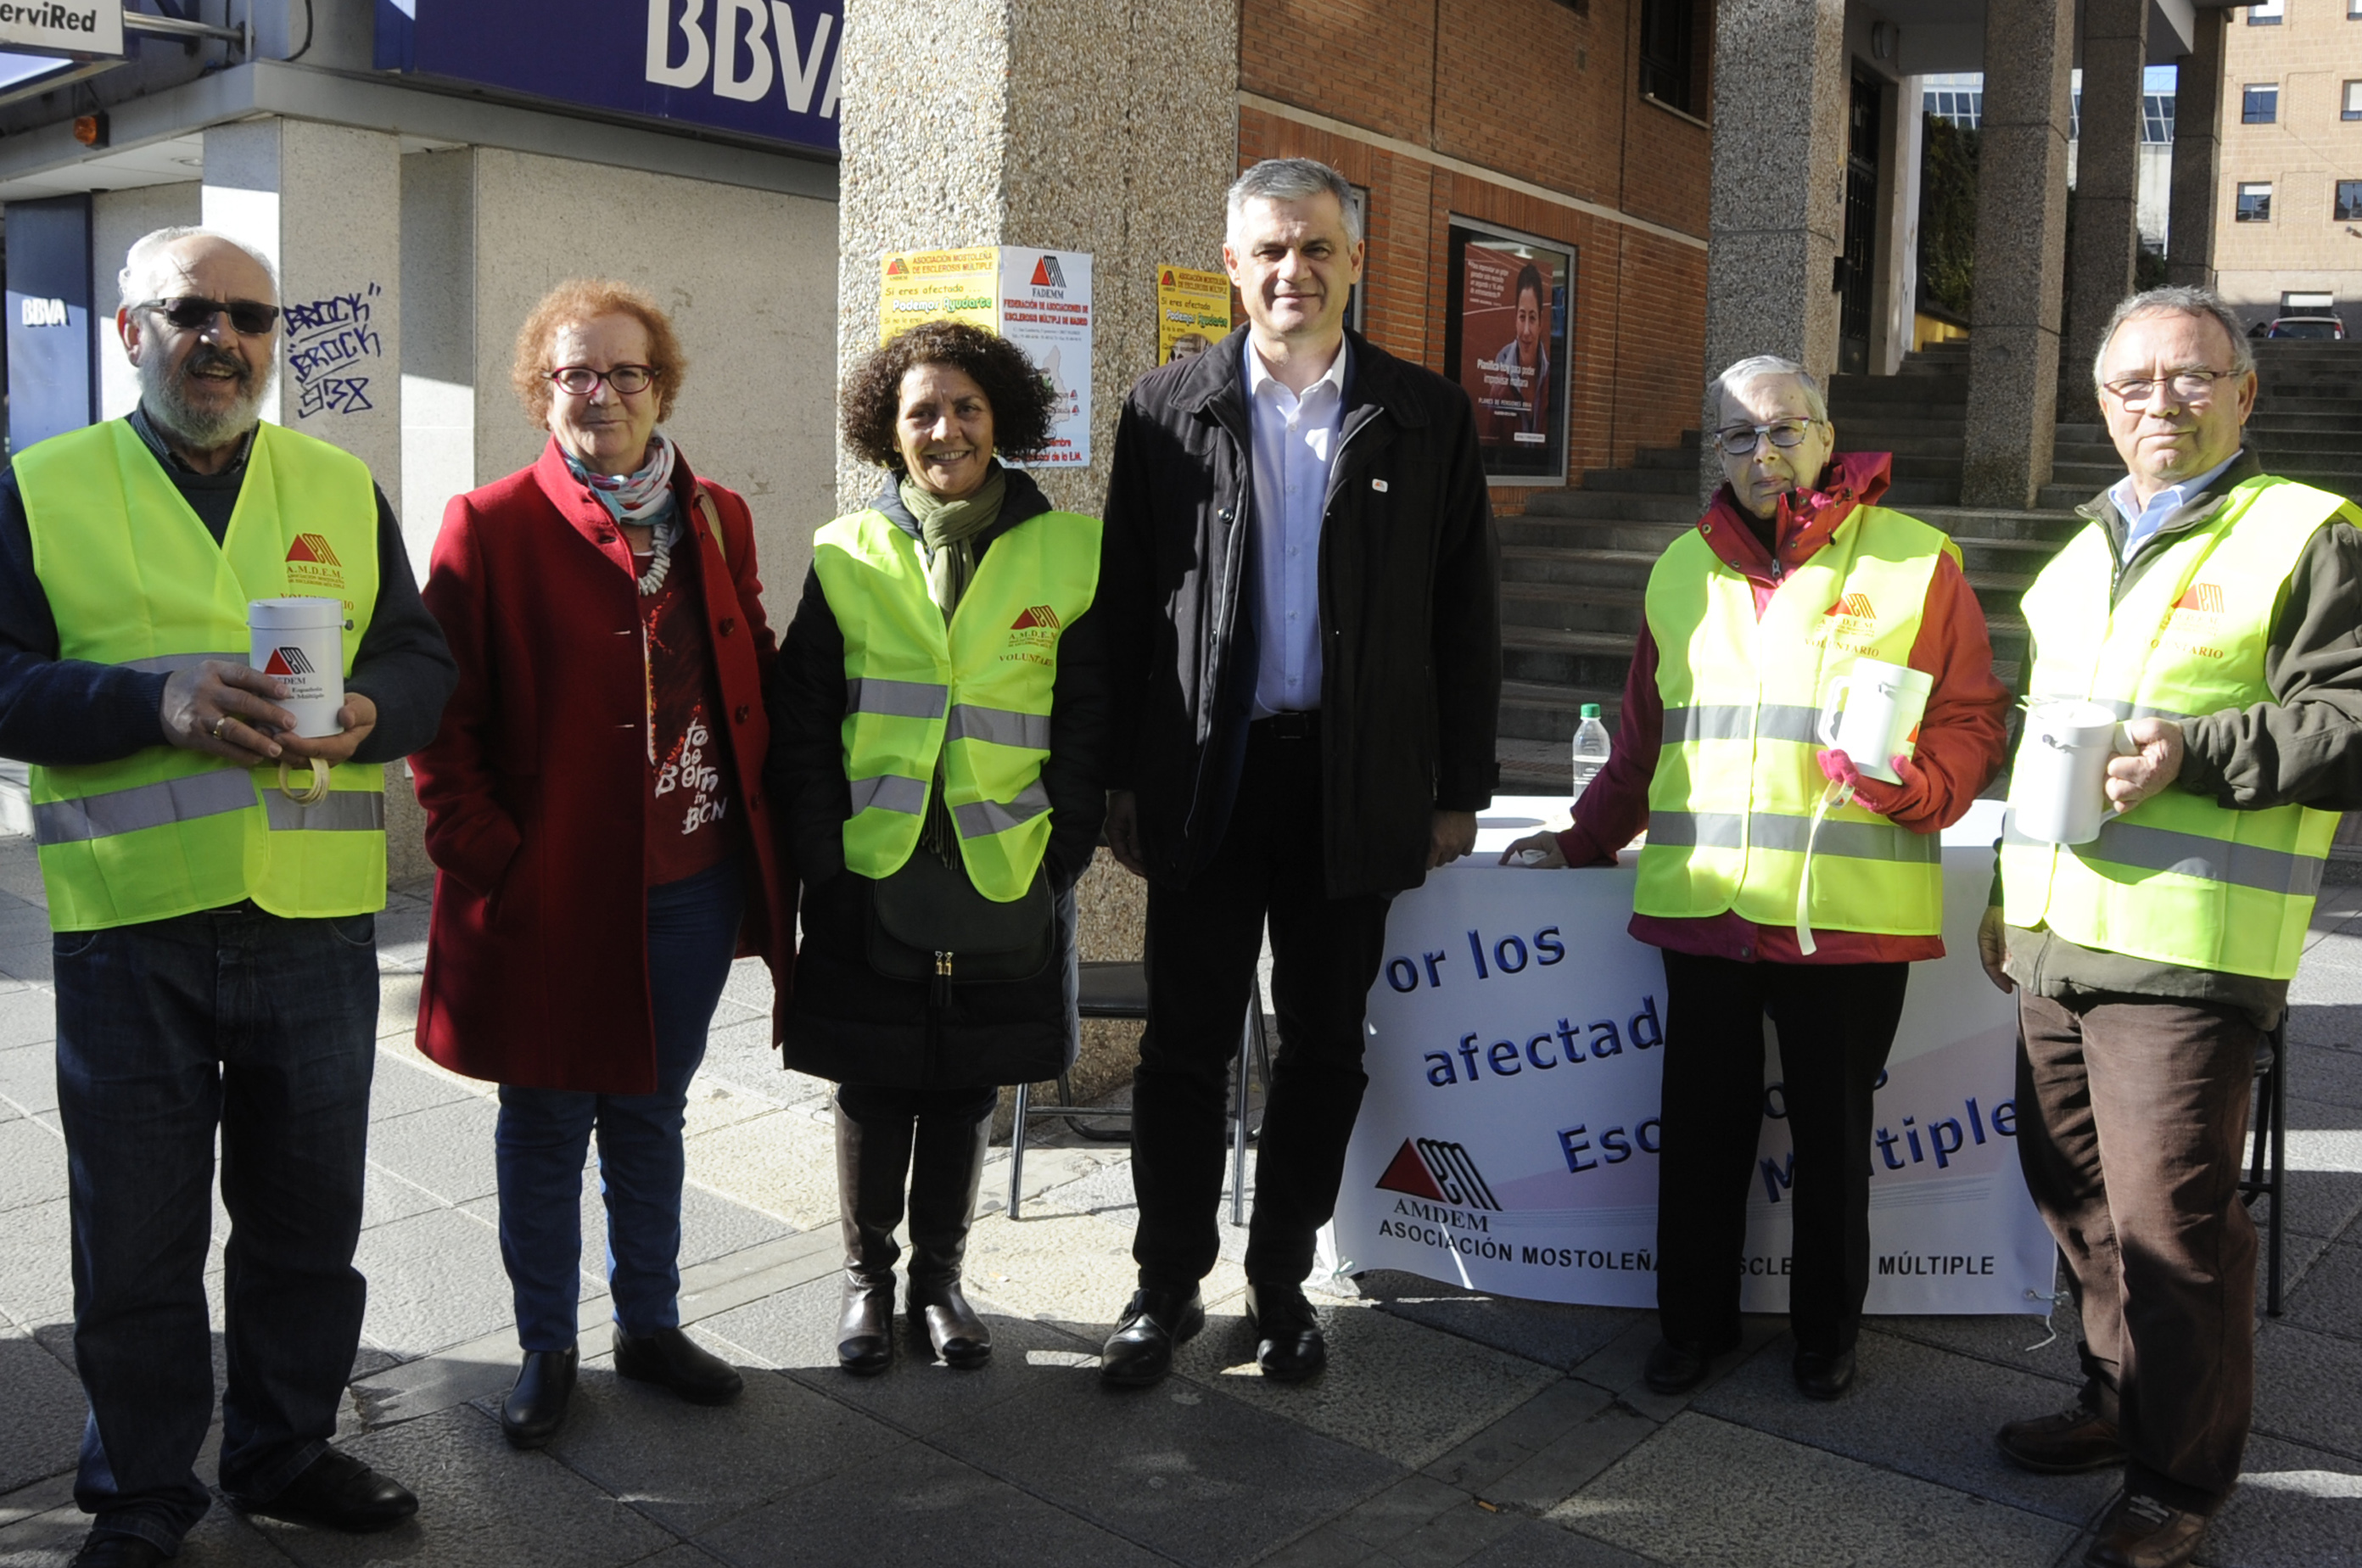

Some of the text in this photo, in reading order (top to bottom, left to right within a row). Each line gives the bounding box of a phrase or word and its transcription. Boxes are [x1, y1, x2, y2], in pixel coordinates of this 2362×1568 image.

[0, 1, 97, 33] erviRed
[885, 287, 894, 296] Si
[898, 287, 919, 296] eres
[922, 283, 964, 294] afectado
[893, 295, 993, 314] Podemos Ayudarte
[1032, 288, 1064, 300] FADEMM
[22, 298, 67, 326] BBVA
[1184, 300, 1211, 310] afectado
[681, 798, 727, 835] BCN
[1385, 925, 1566, 994] or los
[1424, 994, 1664, 1088] afectad
[1393, 1198, 1490, 1233] AMDEM
[1379, 1219, 1658, 1272] ASOCIACIÓN MOSTOLEÑ
[1878, 1251, 1995, 1275] MÚLTIPLE
